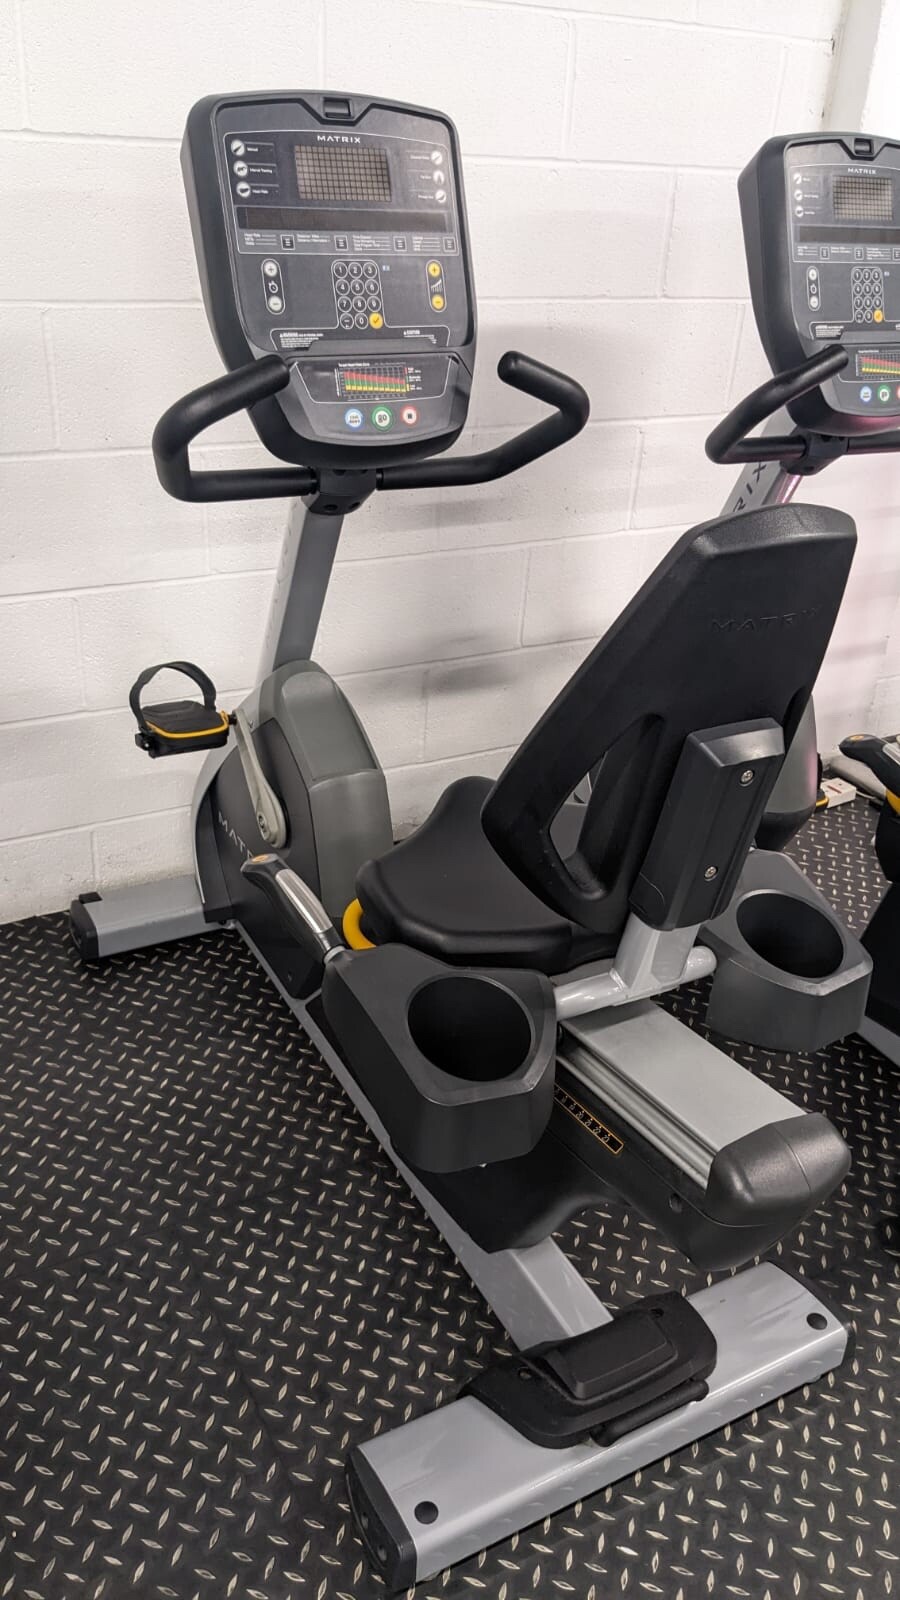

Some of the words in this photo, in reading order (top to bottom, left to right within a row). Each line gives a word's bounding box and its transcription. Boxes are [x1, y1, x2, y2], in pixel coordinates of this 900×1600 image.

[317, 135, 361, 144] MATRIX
[847, 167, 877, 175] MATRIX
[377, 414, 388, 423] go
